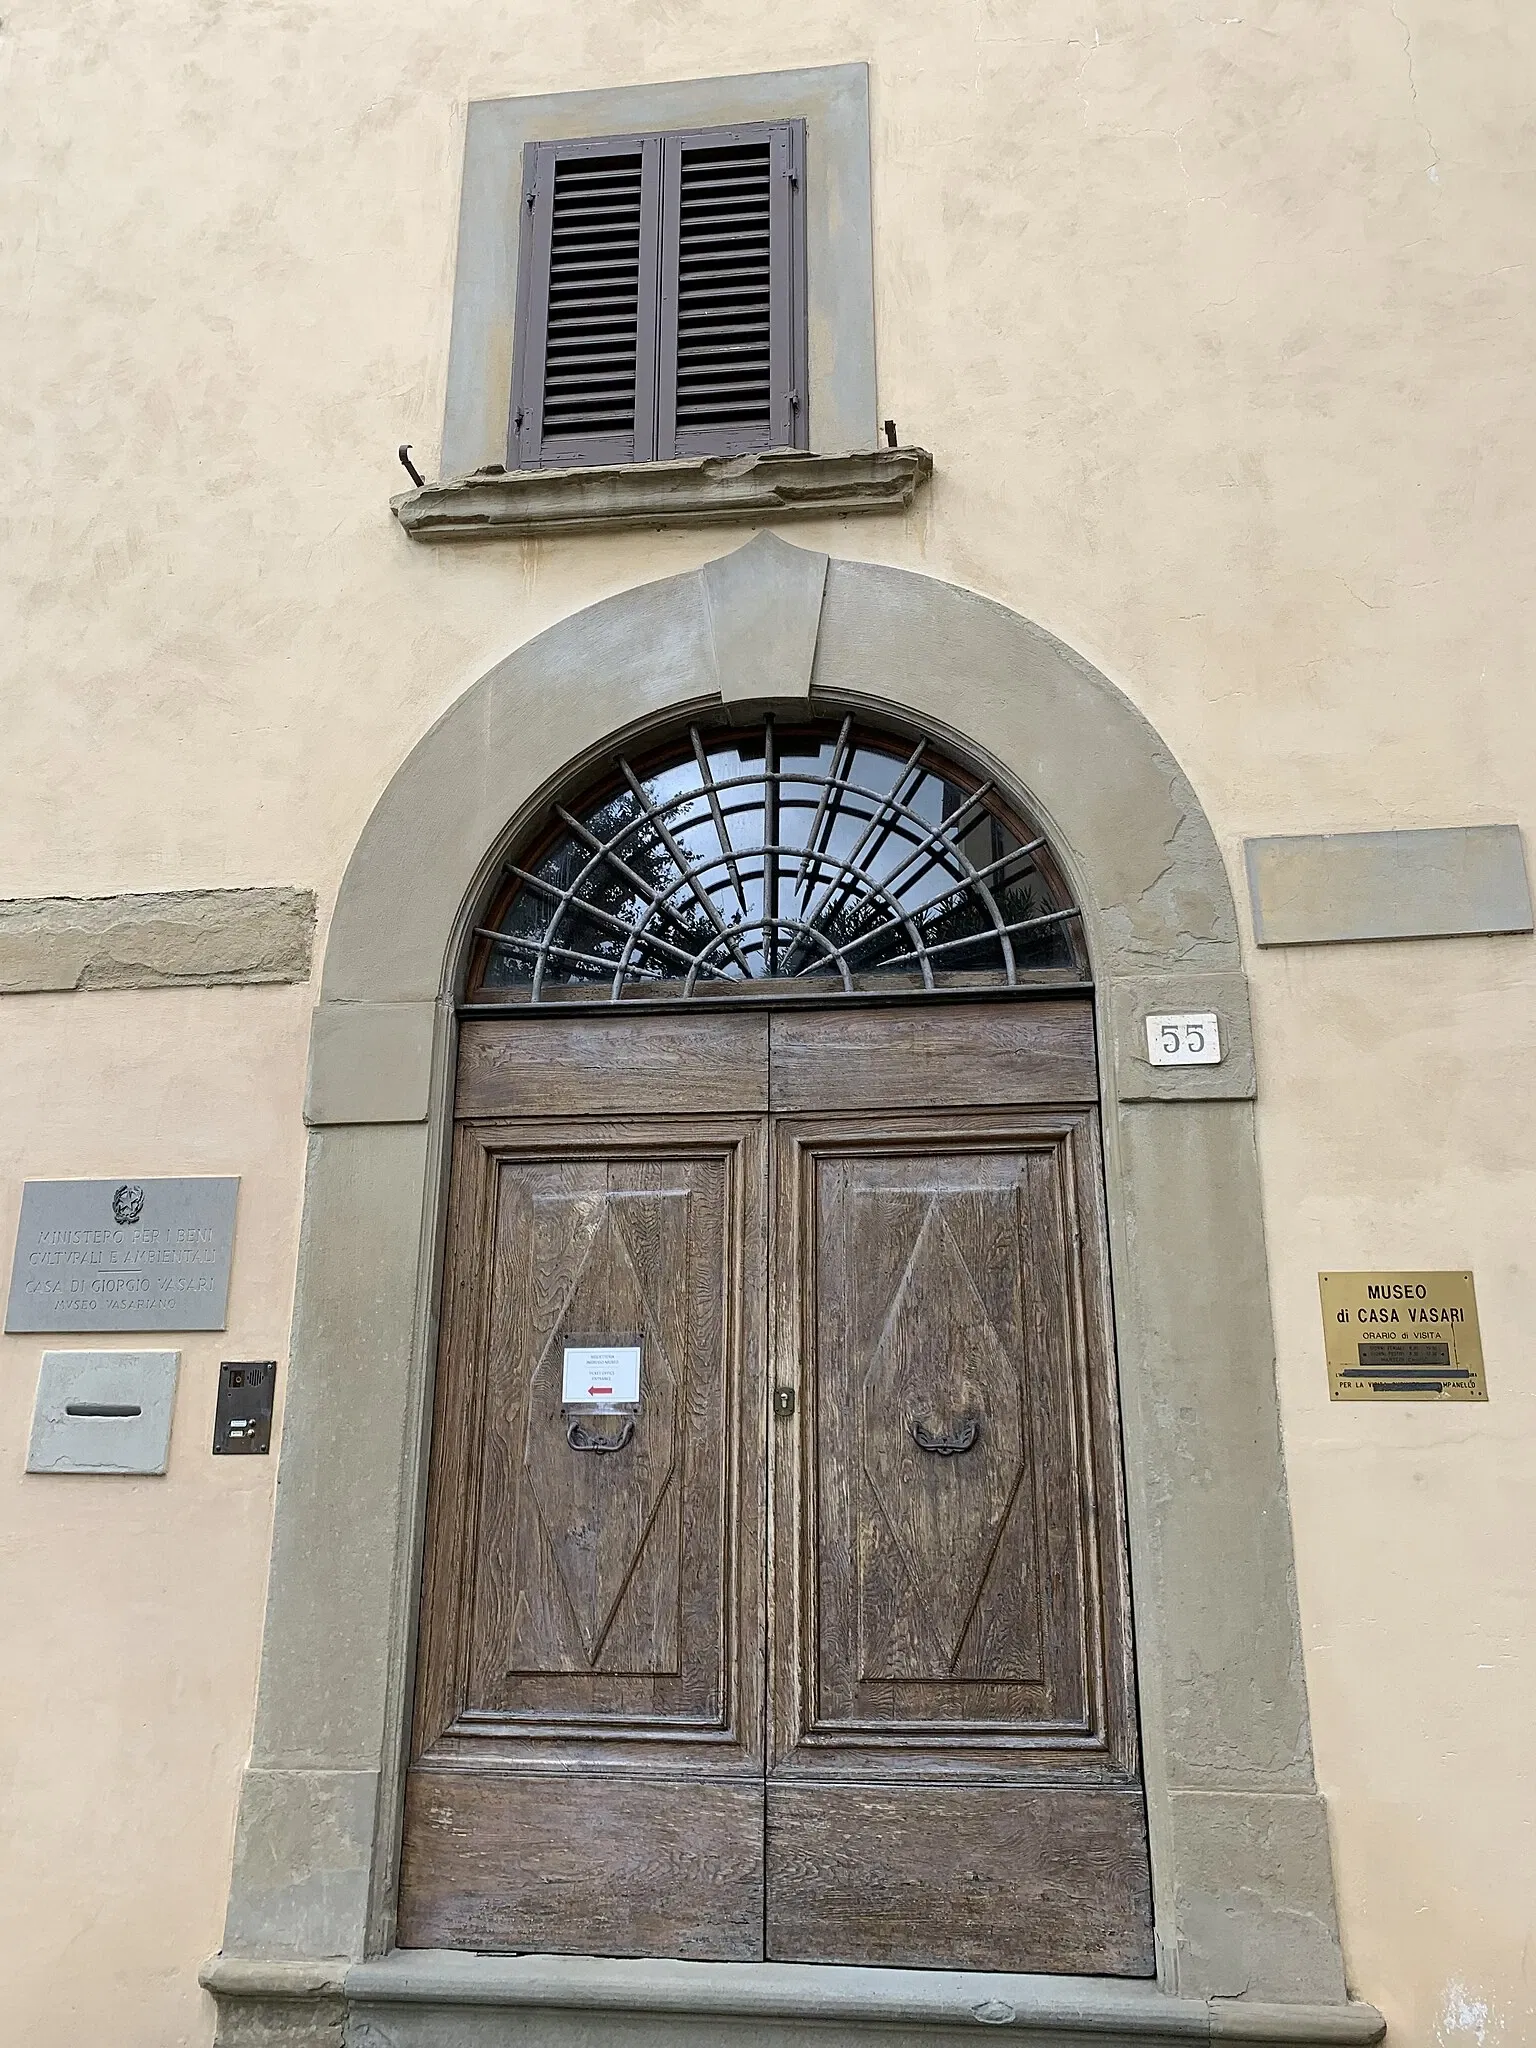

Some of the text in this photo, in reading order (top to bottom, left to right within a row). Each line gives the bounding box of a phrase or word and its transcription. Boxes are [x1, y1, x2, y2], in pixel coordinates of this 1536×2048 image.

[1161, 1024, 1205, 1053] 55
[38, 1228, 213, 1244] MINISTERO PER I BENI
[109, 1250, 118, 1264] E
[123, 1248, 217, 1264] AMBIENTALI
[25, 1277, 215, 1294] CASA DI GIORGIO VASARI
[1368, 1284, 1427, 1300] MUSEO
[106, 1299, 176, 1310] VASARIANO
[1336, 1307, 1464, 1323] di CASA VASARI
[1362, 1331, 1442, 1340] ORARIO di VISITA
[1442, 1381, 1476, 1389] MPANELLO
